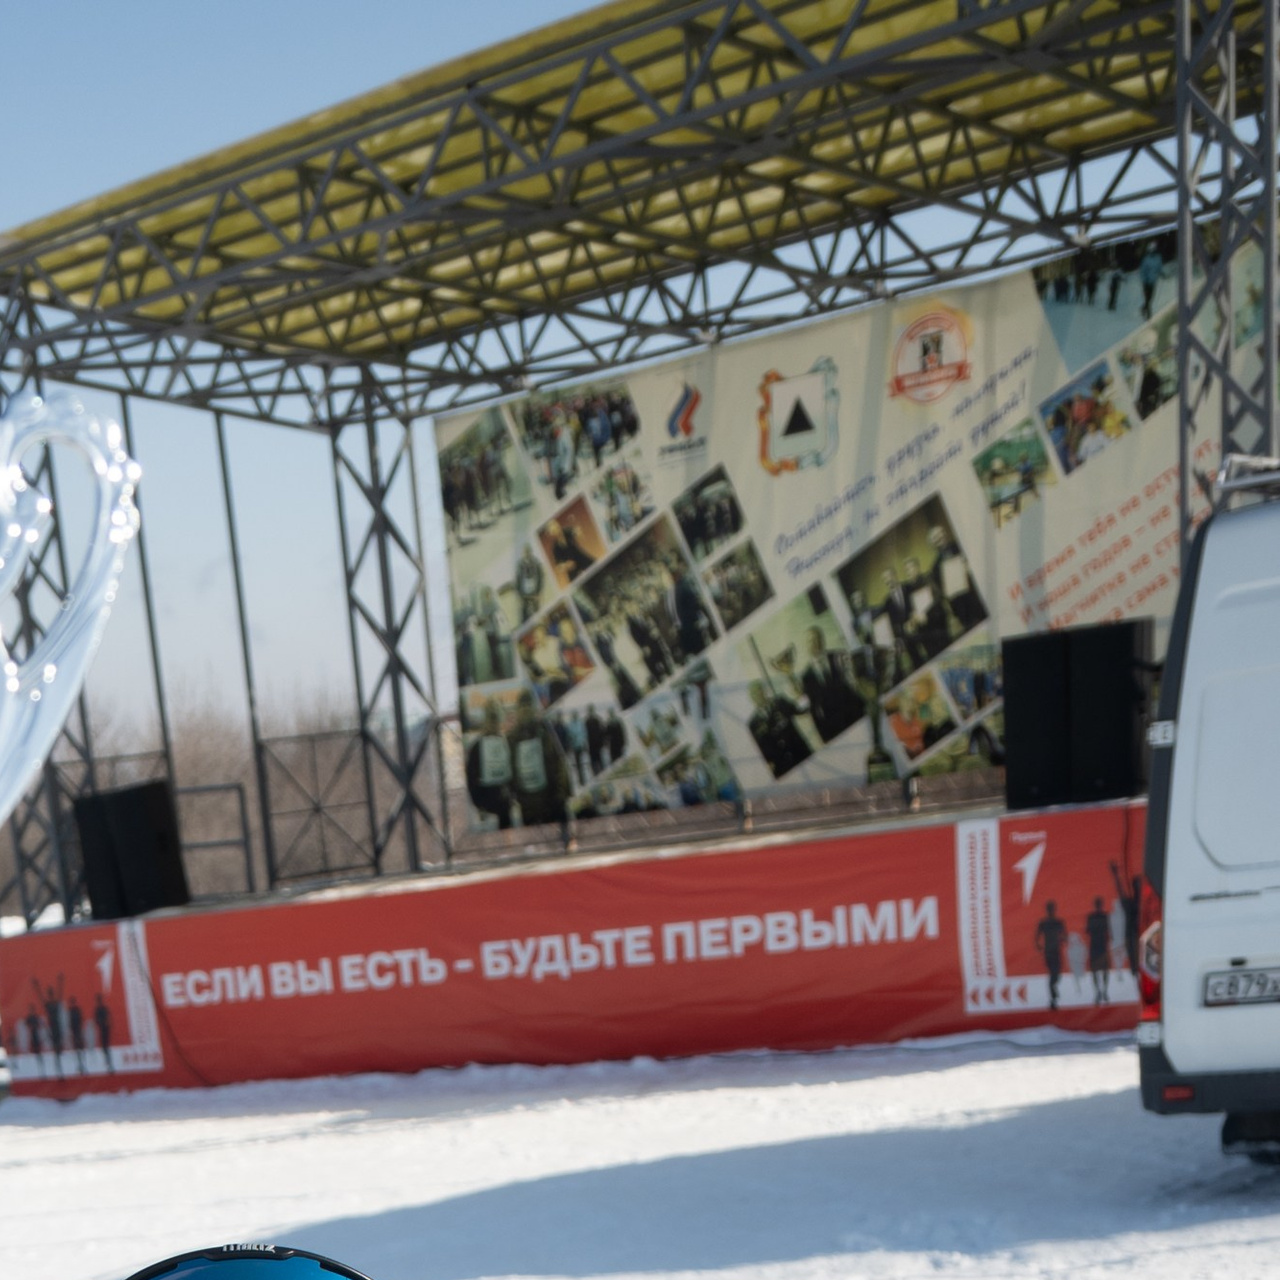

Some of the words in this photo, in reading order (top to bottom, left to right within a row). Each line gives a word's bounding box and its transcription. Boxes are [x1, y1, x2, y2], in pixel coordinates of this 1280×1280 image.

[160, 963, 265, 1008] ЕСЛИ
[269, 957, 333, 998] ВЫ
[337, 947, 447, 992] ЕСТЬ
[480, 925, 654, 982] БУДЬТЕ
[661, 896, 939, 964] ПЕРВЫМИ
